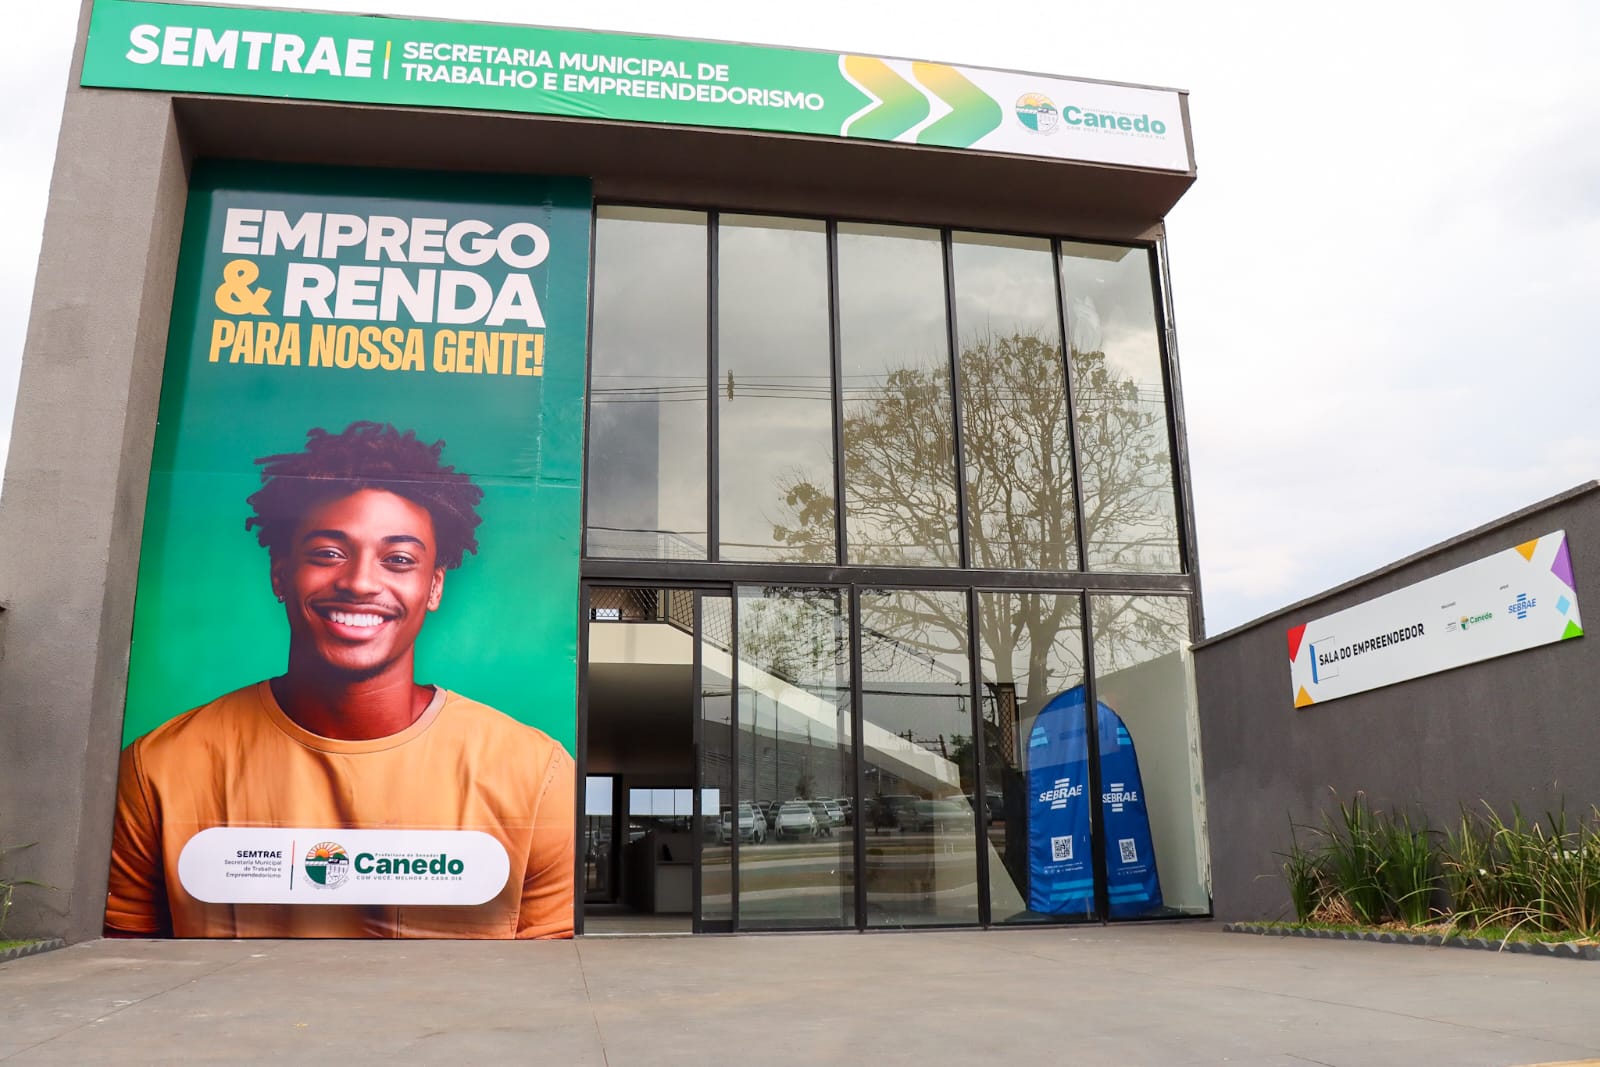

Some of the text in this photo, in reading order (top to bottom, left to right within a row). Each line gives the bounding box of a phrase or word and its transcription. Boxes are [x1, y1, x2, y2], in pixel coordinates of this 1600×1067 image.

[125, 24, 374, 79] SEMTRAE
[402, 41, 729, 82] SECRETARIA MUNICIPAL DE
[401, 63, 824, 111] TRABALHO E EMPREENDEDORISMO
[1062, 105, 1166, 135] Canedo
[222, 207, 550, 269] EMPREGO
[214, 259, 546, 328] & RENDA
[209, 319, 545, 377] PARA NOSSA GENTE!
[1469, 612, 1493, 624] Canedo
[1508, 598, 1537, 613] SEBRAE
[1319, 623, 1425, 666] SALA DO EMPREENDEDOR
[1039, 784, 1083, 802] SEBRAE
[1102, 791, 1138, 803] SEBRAE
[237, 850, 282, 858] SEMTRAE
[354, 852, 464, 875] Canedo
